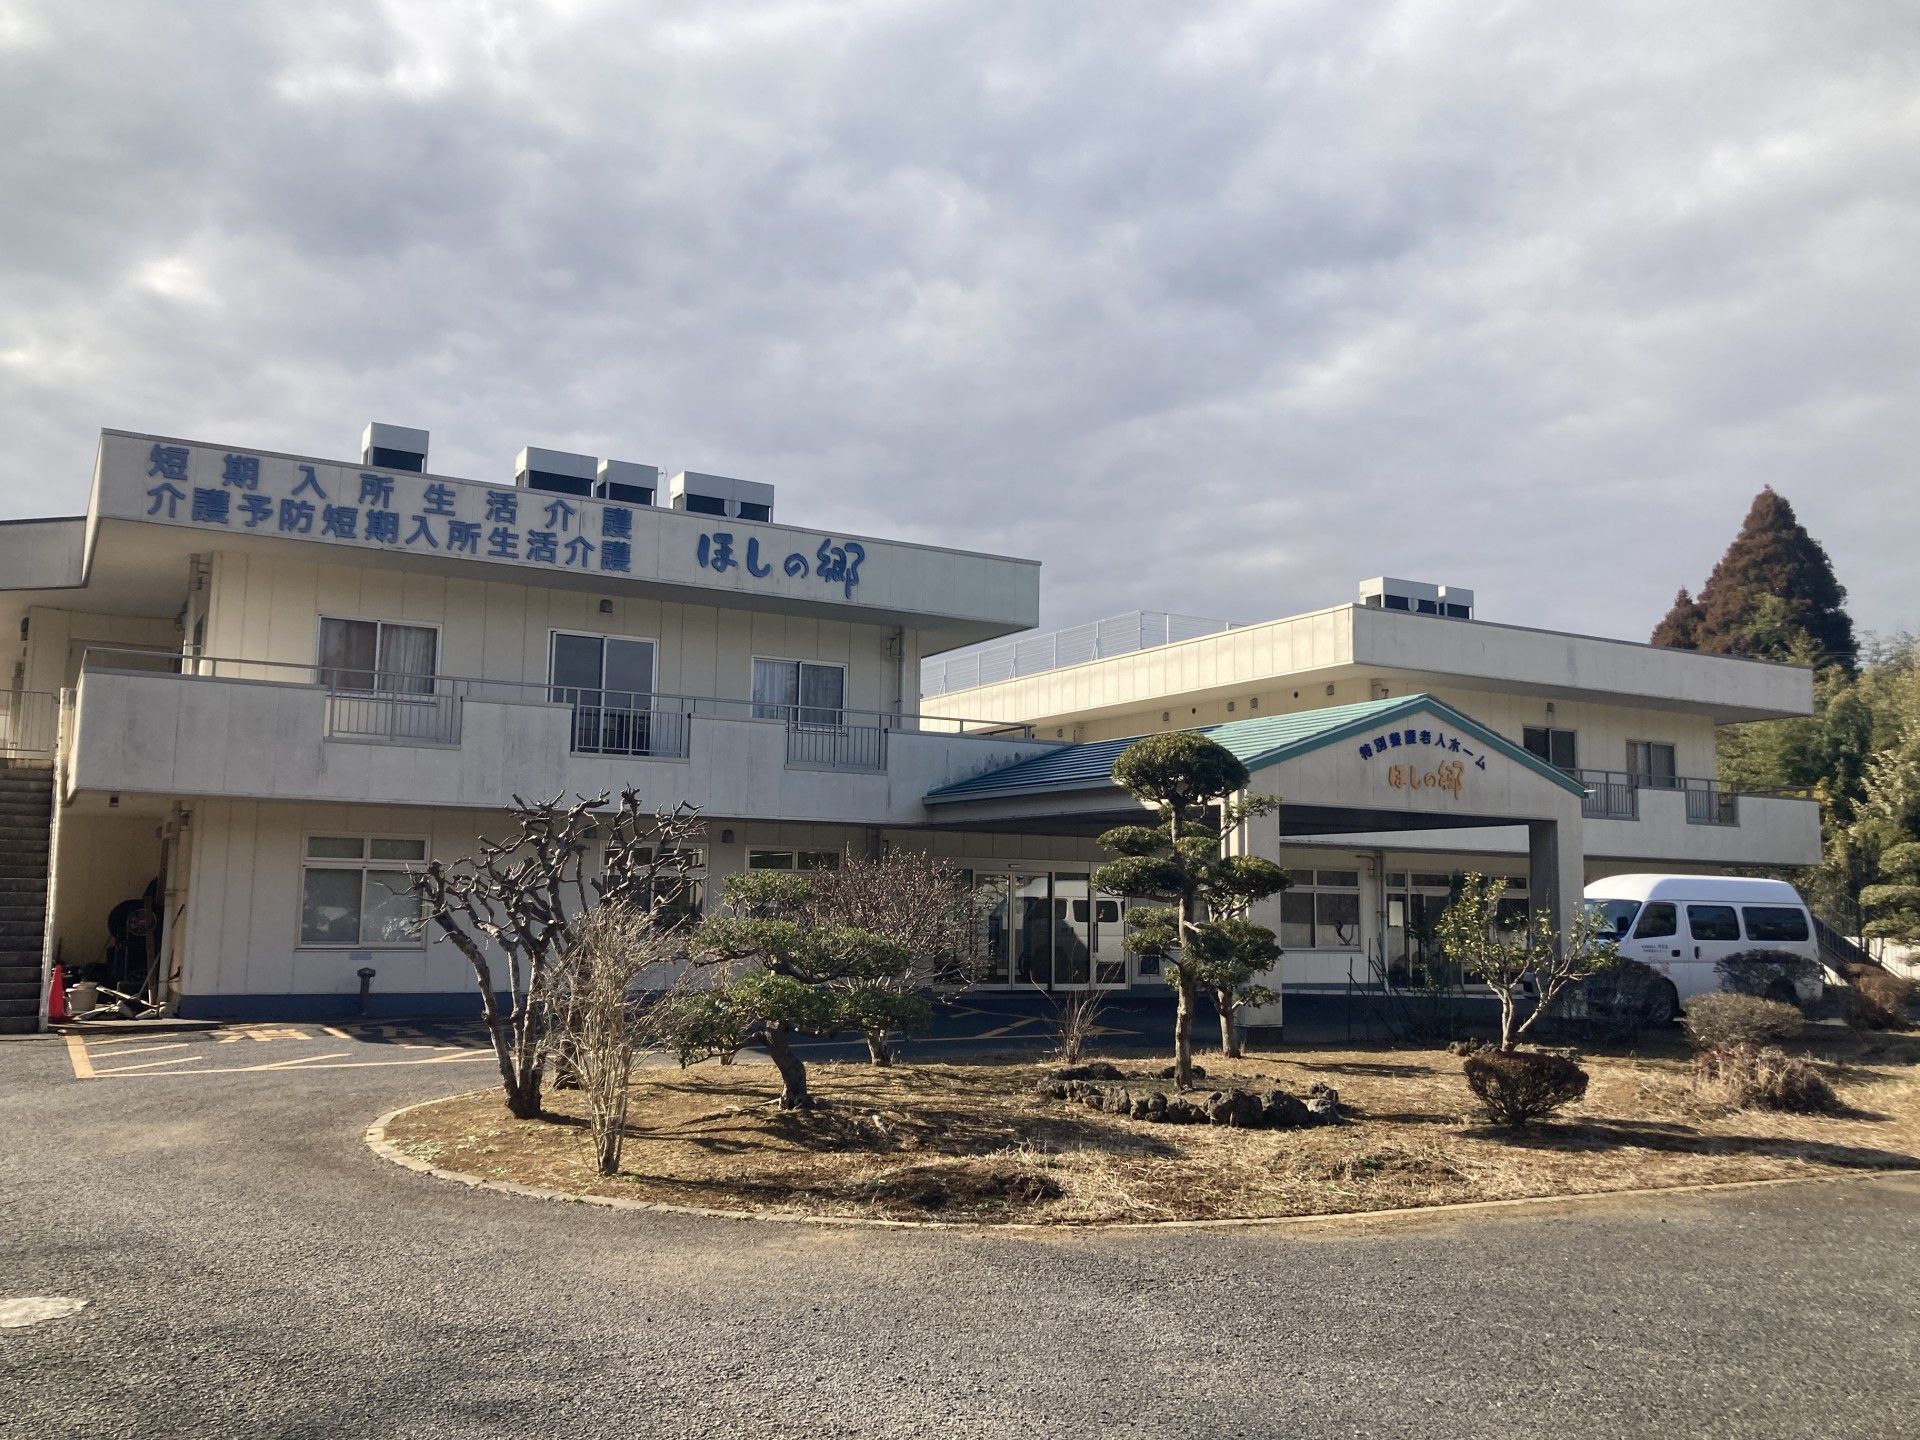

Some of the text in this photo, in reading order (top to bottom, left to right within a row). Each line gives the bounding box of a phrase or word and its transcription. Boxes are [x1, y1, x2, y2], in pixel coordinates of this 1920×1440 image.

[146, 482, 632, 572] 介護予防短期入所生活介護
[149, 444, 632, 538] 短期入所生活介護
[697, 532, 866, 599] ほしの郷
